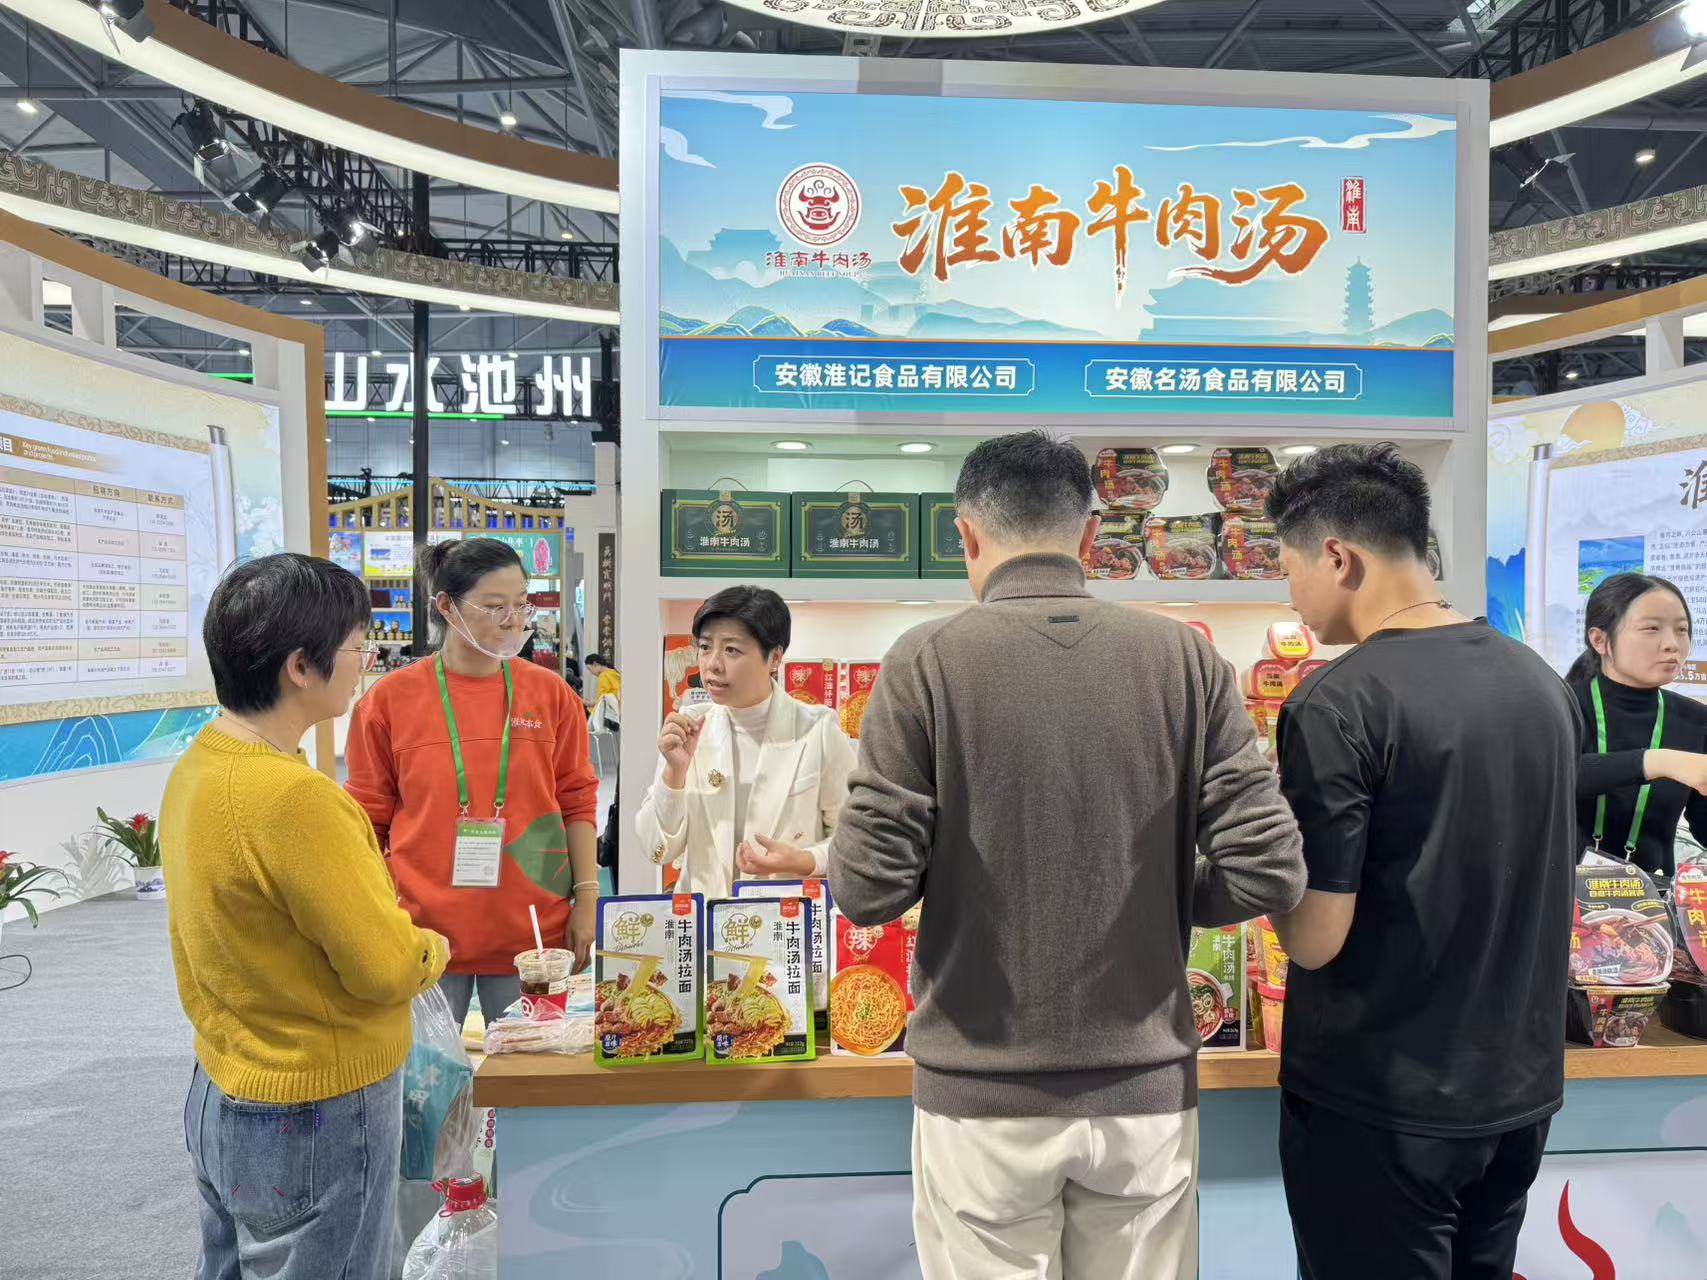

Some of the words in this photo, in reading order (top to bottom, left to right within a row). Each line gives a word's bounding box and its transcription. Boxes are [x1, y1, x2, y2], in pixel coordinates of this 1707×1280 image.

[892, 165, 1329, 308] 淮南牛肉汤
[766, 250, 872, 269] 淮南牛肉汤
[325, 351, 592, 417] 山水池州
[774, 362, 1017, 389] 安徽淮记食品有限公司
[1105, 366, 1345, 393] 安徽名汤食品有限公司
[716, 510, 734, 528] 汤
[846, 512, 864, 529] 汤
[700, 536, 750, 548] 淮南牛肉汤
[829, 538, 879, 549] 淮南牛肉汤
[664, 919, 675, 940] 淮南
[773, 921, 783, 941] 淮南
[677, 919, 692, 993] 牛肉汤拉面
[785, 921, 801, 994] 牛肉汤拉面
[1222, 934, 1236, 974] 牛肉汤
